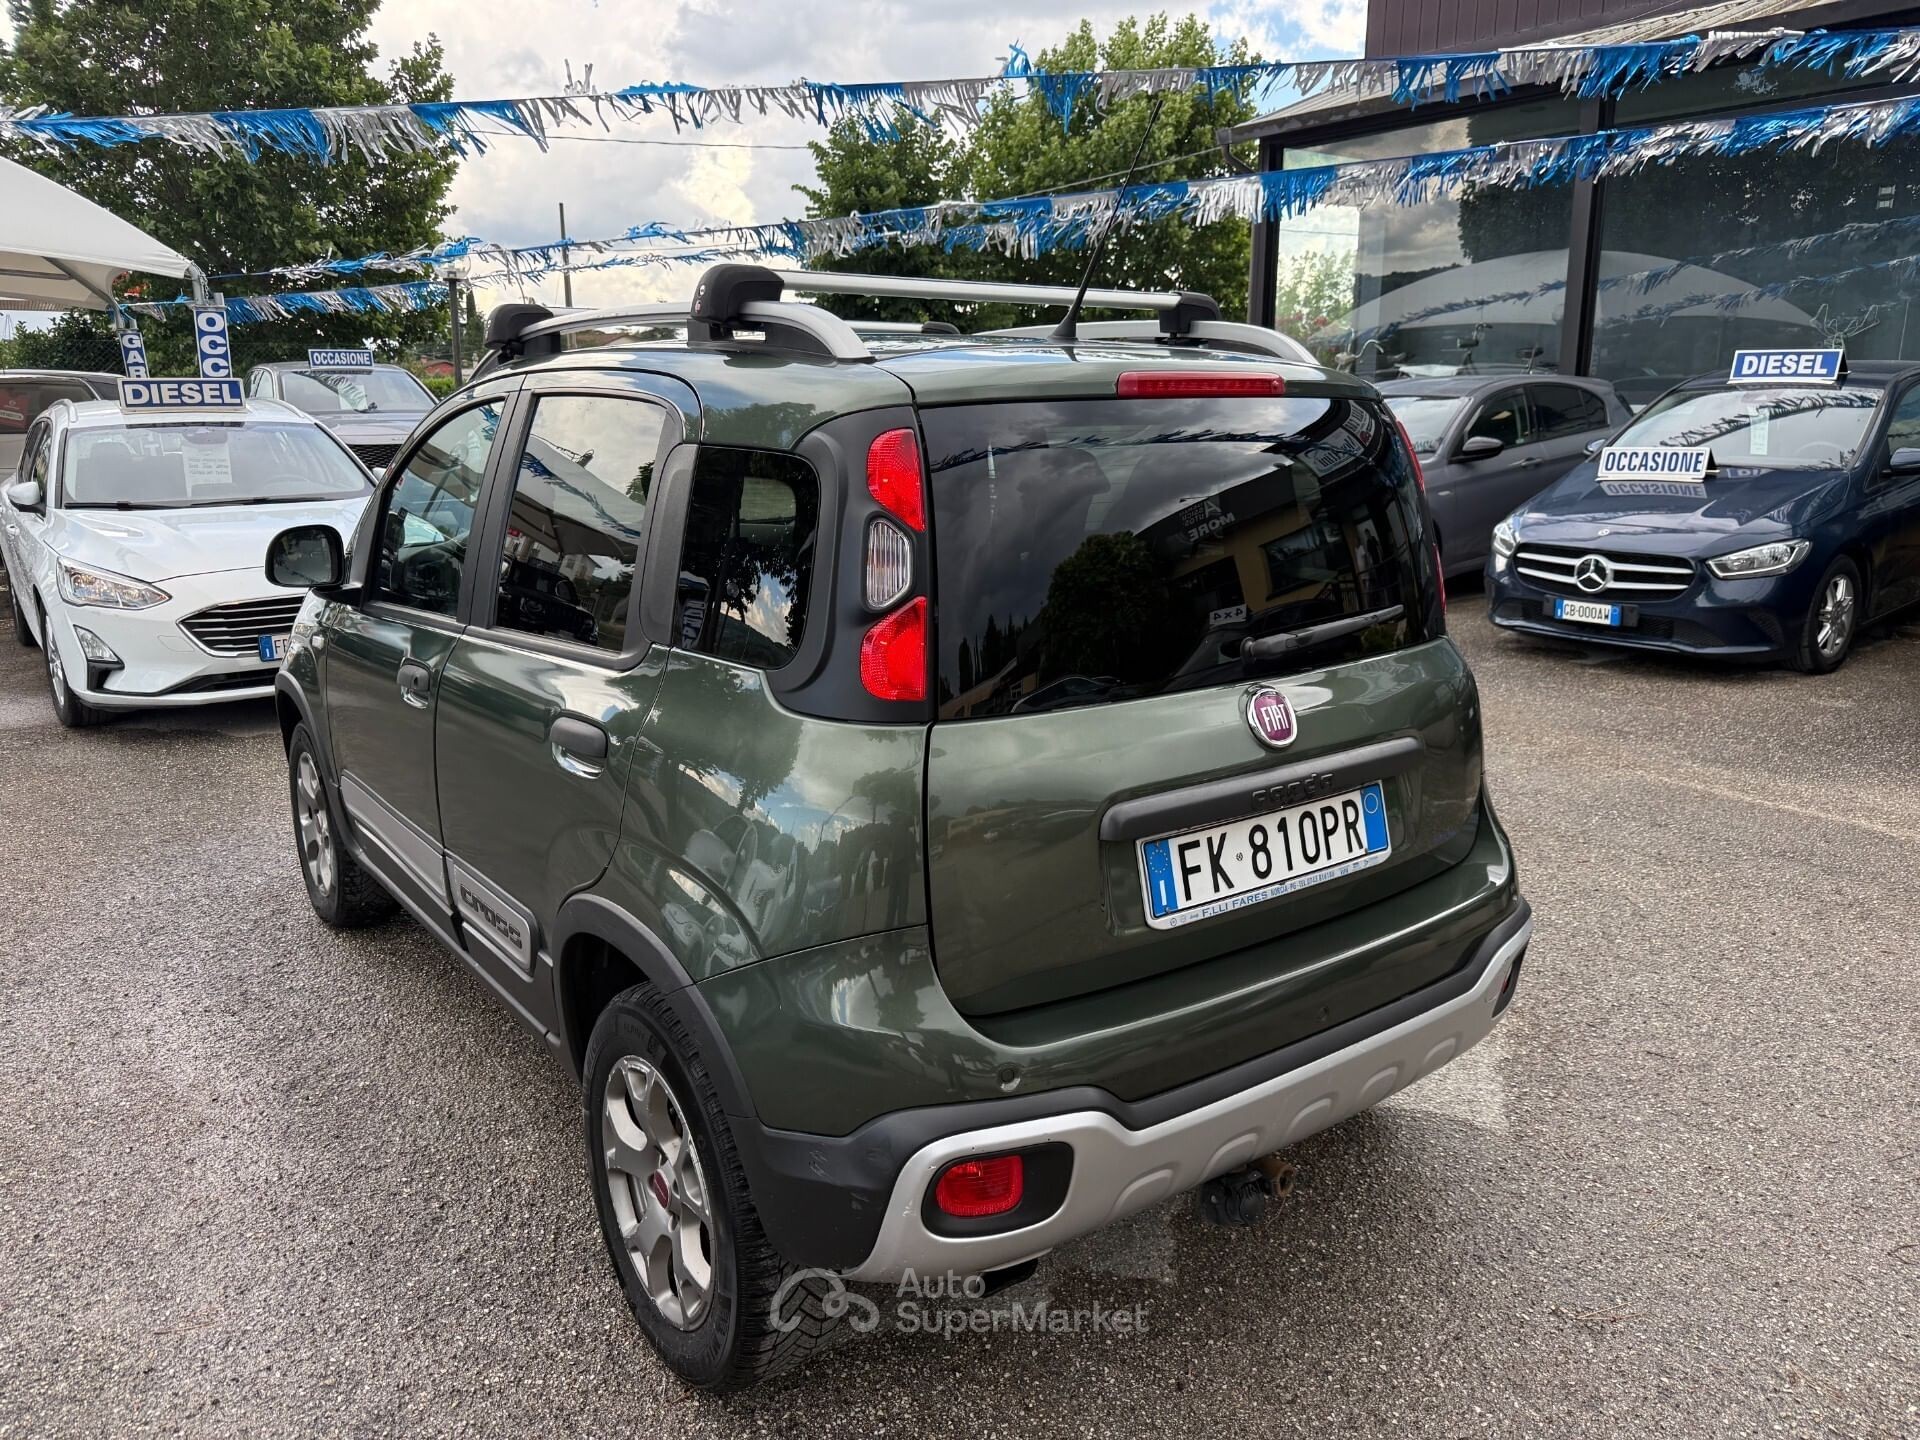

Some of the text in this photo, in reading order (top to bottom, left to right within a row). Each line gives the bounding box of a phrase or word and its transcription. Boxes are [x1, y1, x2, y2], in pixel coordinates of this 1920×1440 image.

[313, 352, 371, 365] OCCASIONE
[1741, 353, 1828, 376] DIESEL
[124, 383, 241, 405] DIESEL
[1604, 451, 1704, 473] OCCASIONE
[1260, 703, 1289, 732] FIAT
[1177, 832, 1235, 902] FK
[1247, 798, 1364, 880] 810PR
[1202, 899, 1229, 917] F.LLI
[1231, 890, 1268, 909] FARES
